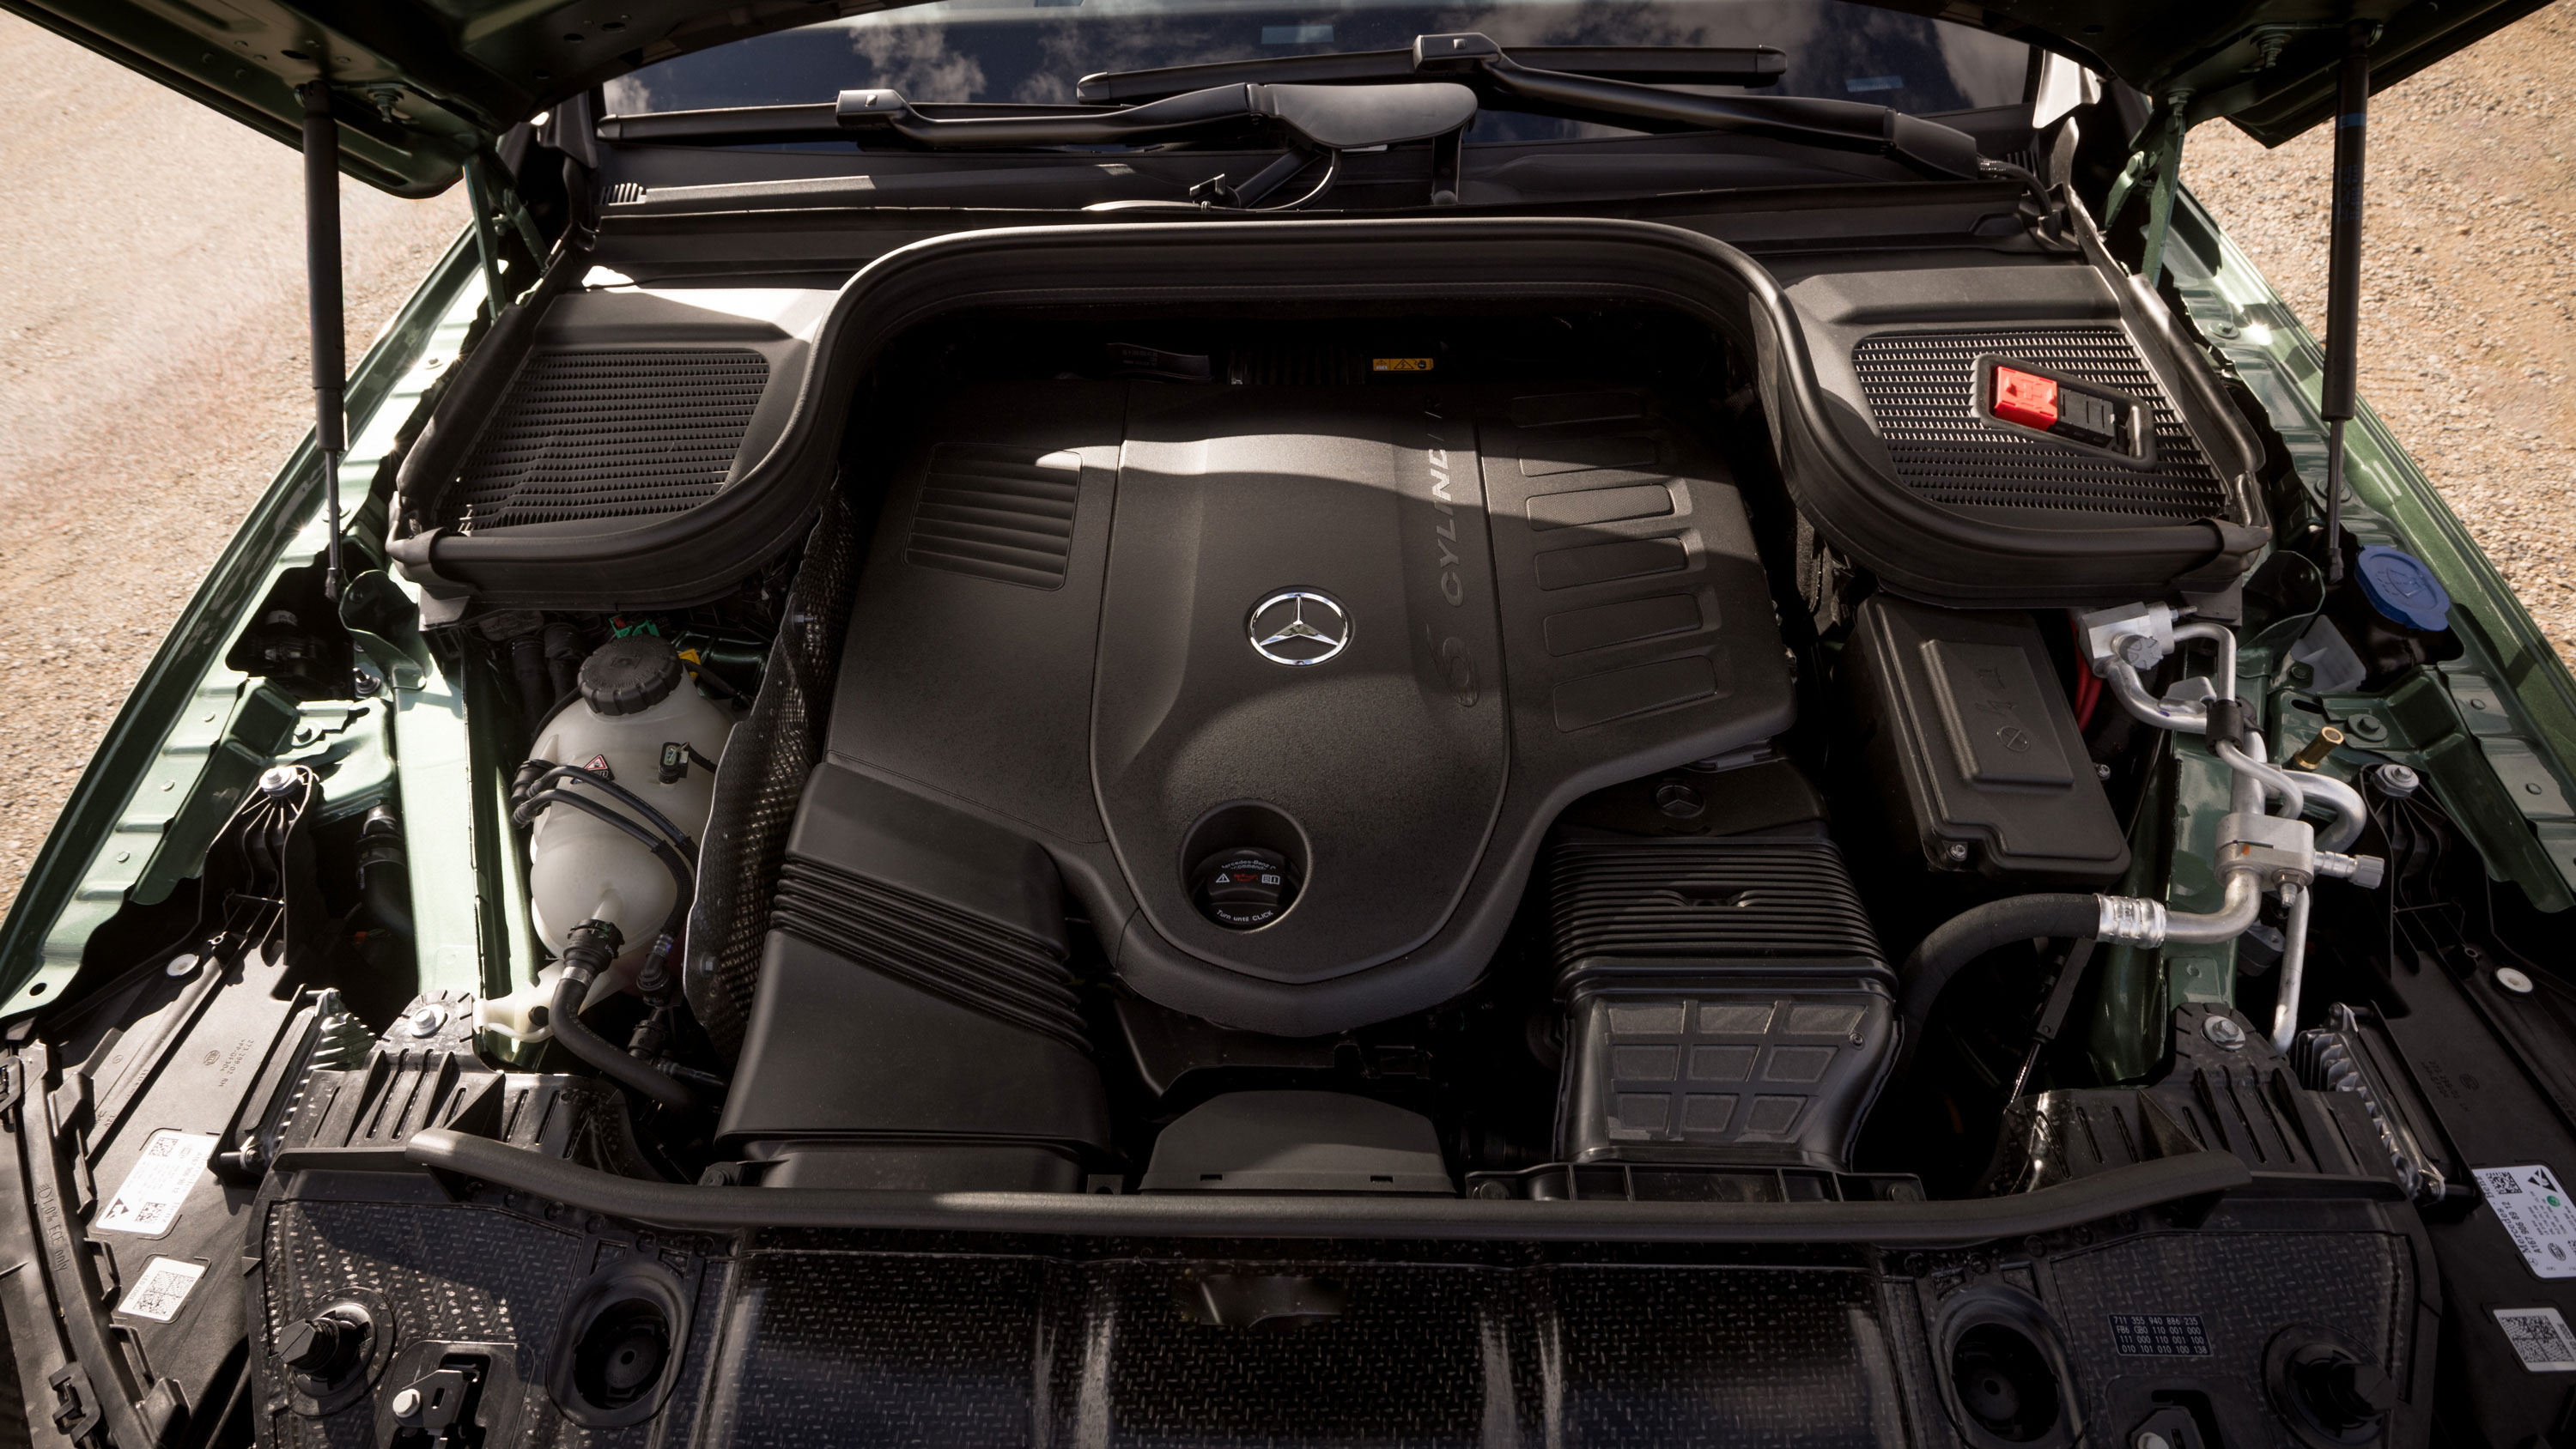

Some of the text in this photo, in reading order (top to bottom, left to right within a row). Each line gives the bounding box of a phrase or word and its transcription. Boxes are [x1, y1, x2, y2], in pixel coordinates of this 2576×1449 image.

[1425, 397, 1464, 607] CYLIND
[1216, 909, 1231, 920] Turn
[1252, 910, 1274, 921] CLICK
[48, 1224, 64, 1246] ECE
[54, 1249, 70, 1271] only
[2113, 1316, 2127, 1325] 711
[2131, 1316, 2145, 1325] 355
[2184, 1317, 2198, 1325] 235
